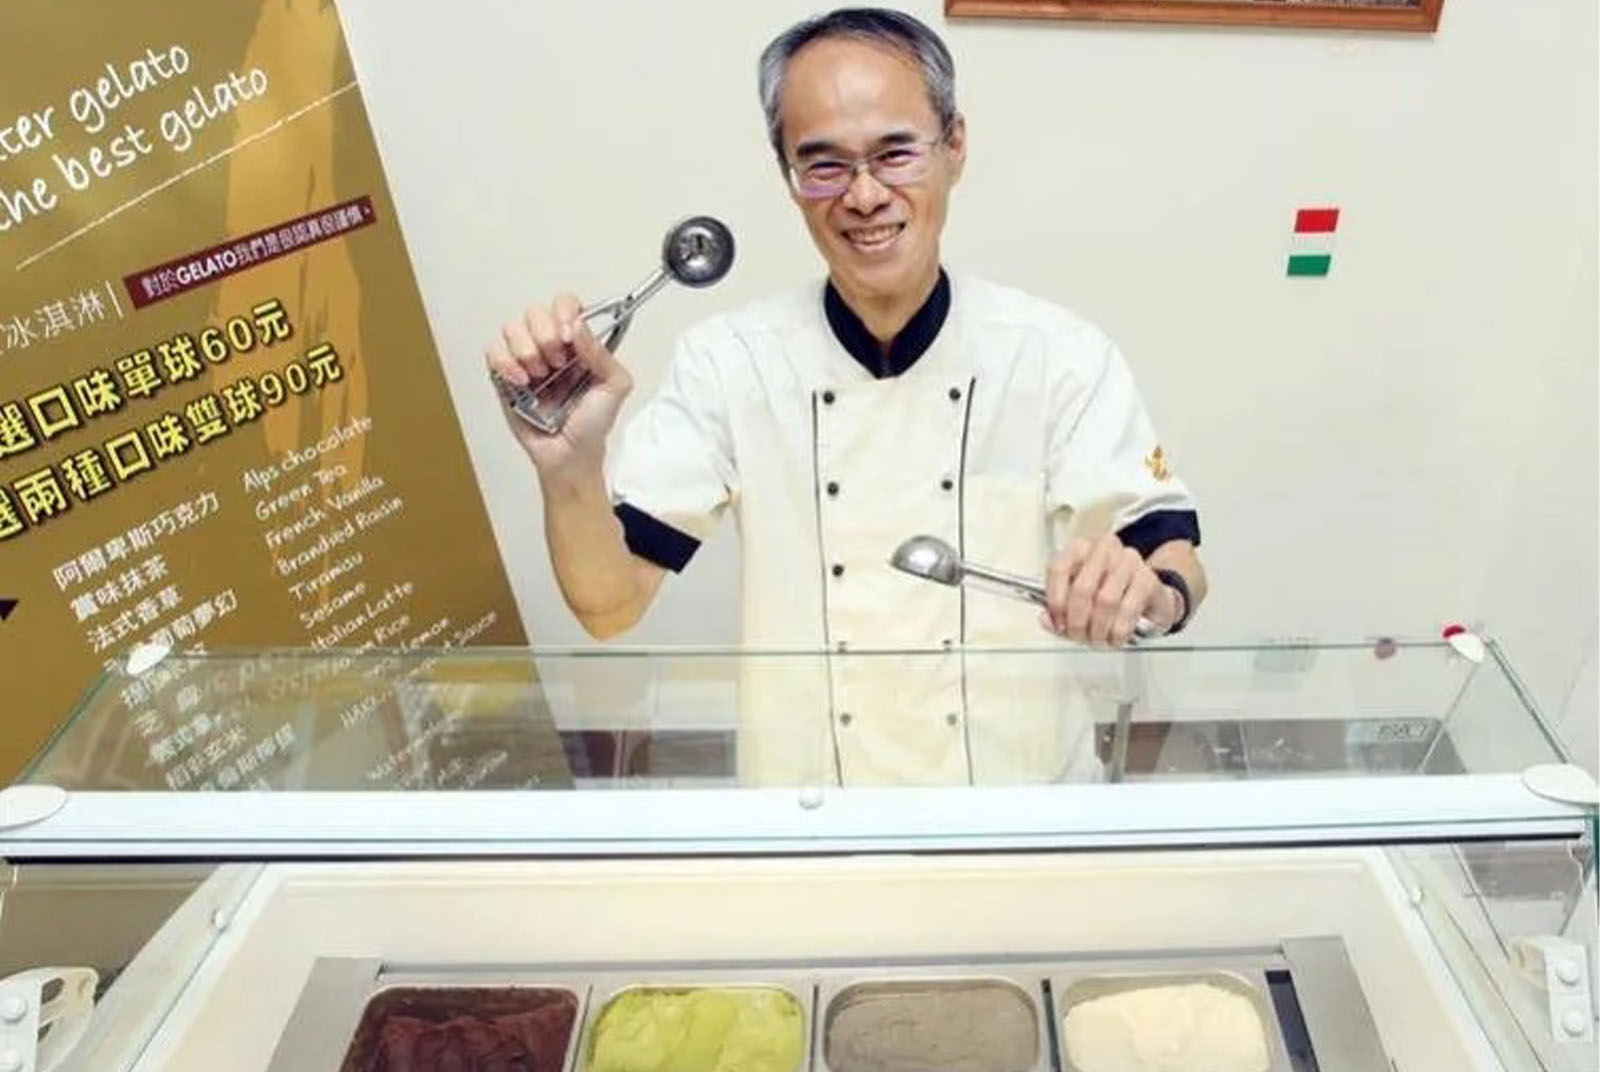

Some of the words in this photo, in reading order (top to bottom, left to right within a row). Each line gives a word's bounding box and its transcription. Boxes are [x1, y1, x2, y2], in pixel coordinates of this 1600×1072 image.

[0, 106, 54, 160] ter
[69, 45, 190, 133] gelato
[51, 124, 153, 191] best
[160, 68, 268, 152] gelato
[243, 464, 280, 493] Alps
[281, 415, 373, 472] chocolate
[254, 483, 314, 521] Green
[312, 464, 347, 486] Tea
[264, 506, 327, 550] French
[326, 474, 385, 512] Vanilla
[300, 582, 366, 630] Sesame
